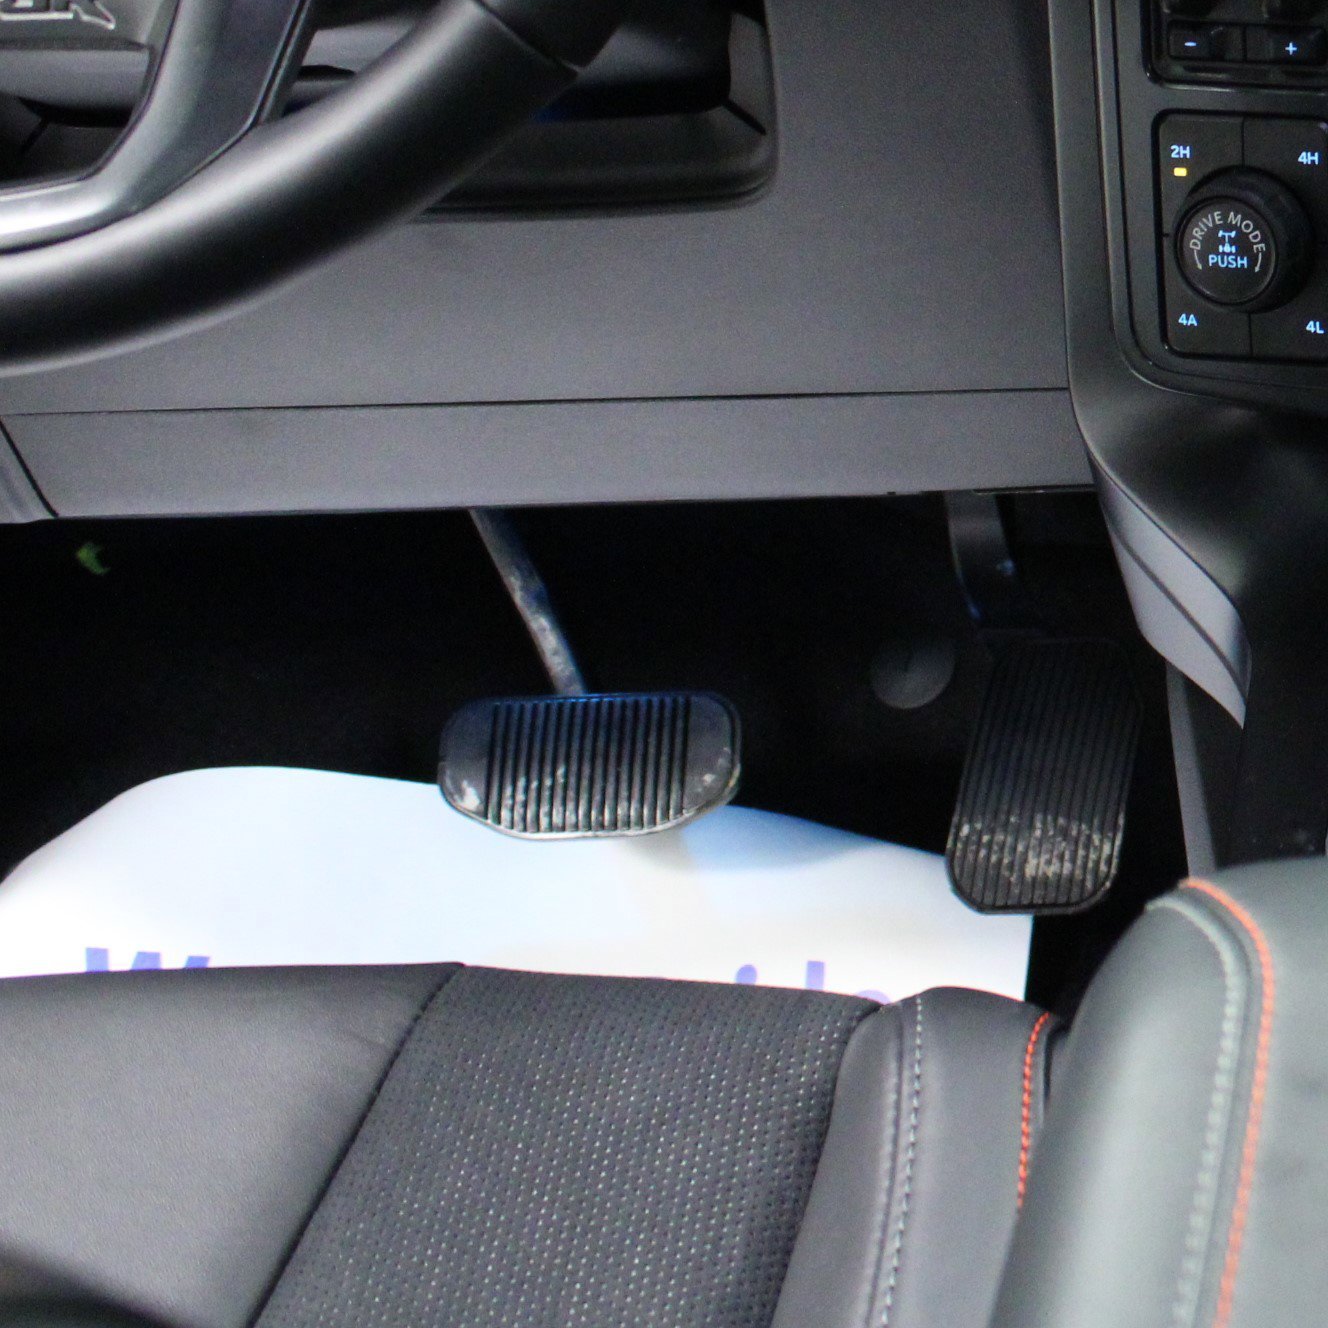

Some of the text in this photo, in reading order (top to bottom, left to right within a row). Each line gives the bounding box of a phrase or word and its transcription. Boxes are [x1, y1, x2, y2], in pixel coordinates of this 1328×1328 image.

[1170, 145, 1191, 159] 2H
[1298, 151, 1319, 165] 4H
[1189, 211, 1266, 253] DRIVE MODE
[1208, 254, 1248, 269] PUSH
[1178, 313, 1198, 327] 4A
[1306, 321, 1325, 334] 4L
